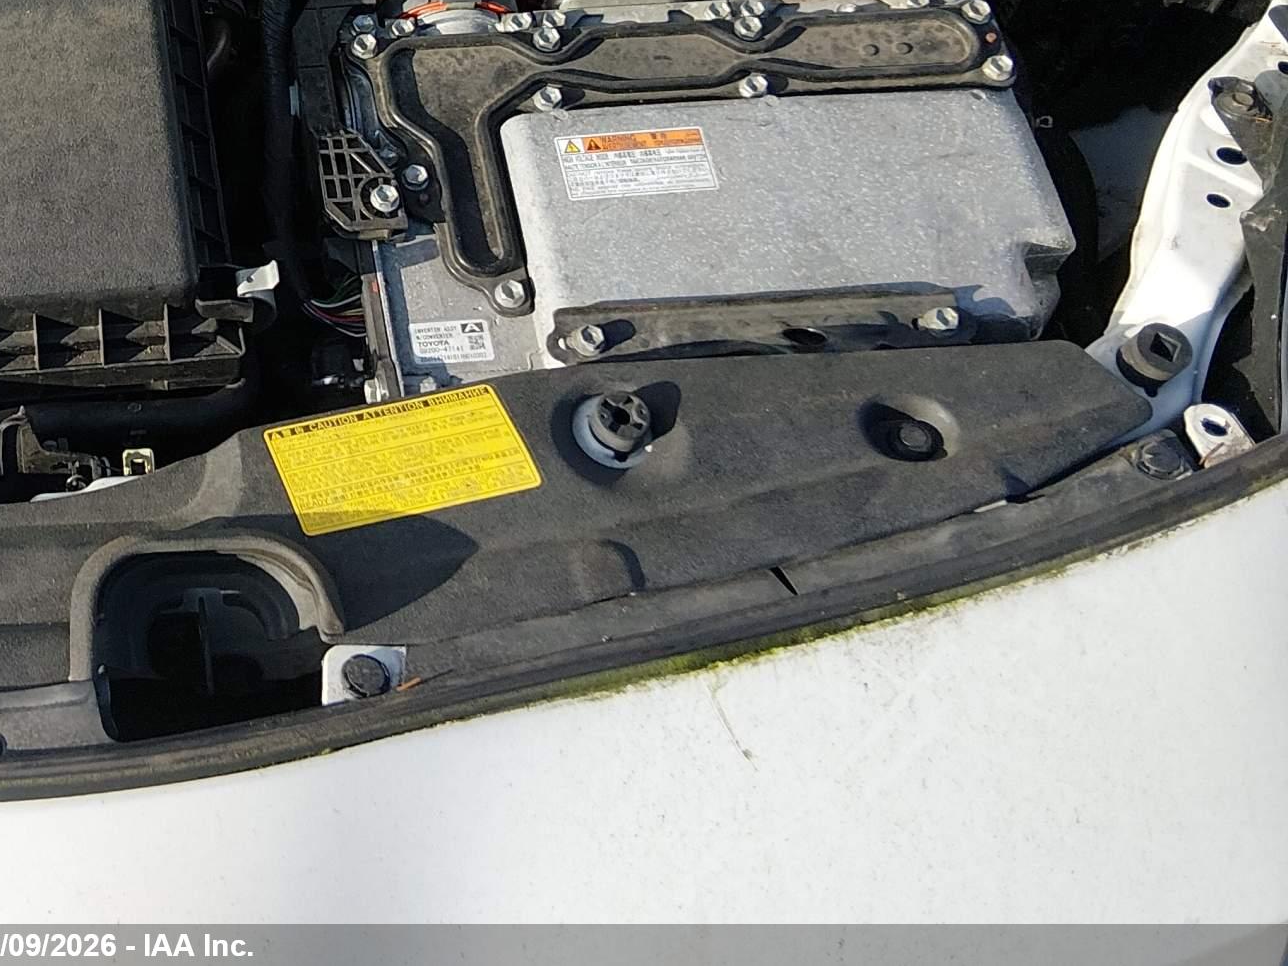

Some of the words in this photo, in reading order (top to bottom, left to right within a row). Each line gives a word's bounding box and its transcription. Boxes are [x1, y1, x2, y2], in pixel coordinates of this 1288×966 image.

[309, 415, 358, 431] CAUTION
[363, 400, 424, 421] ATTENTION
[428, 388, 487, 406] ВНИМАНИЕ
